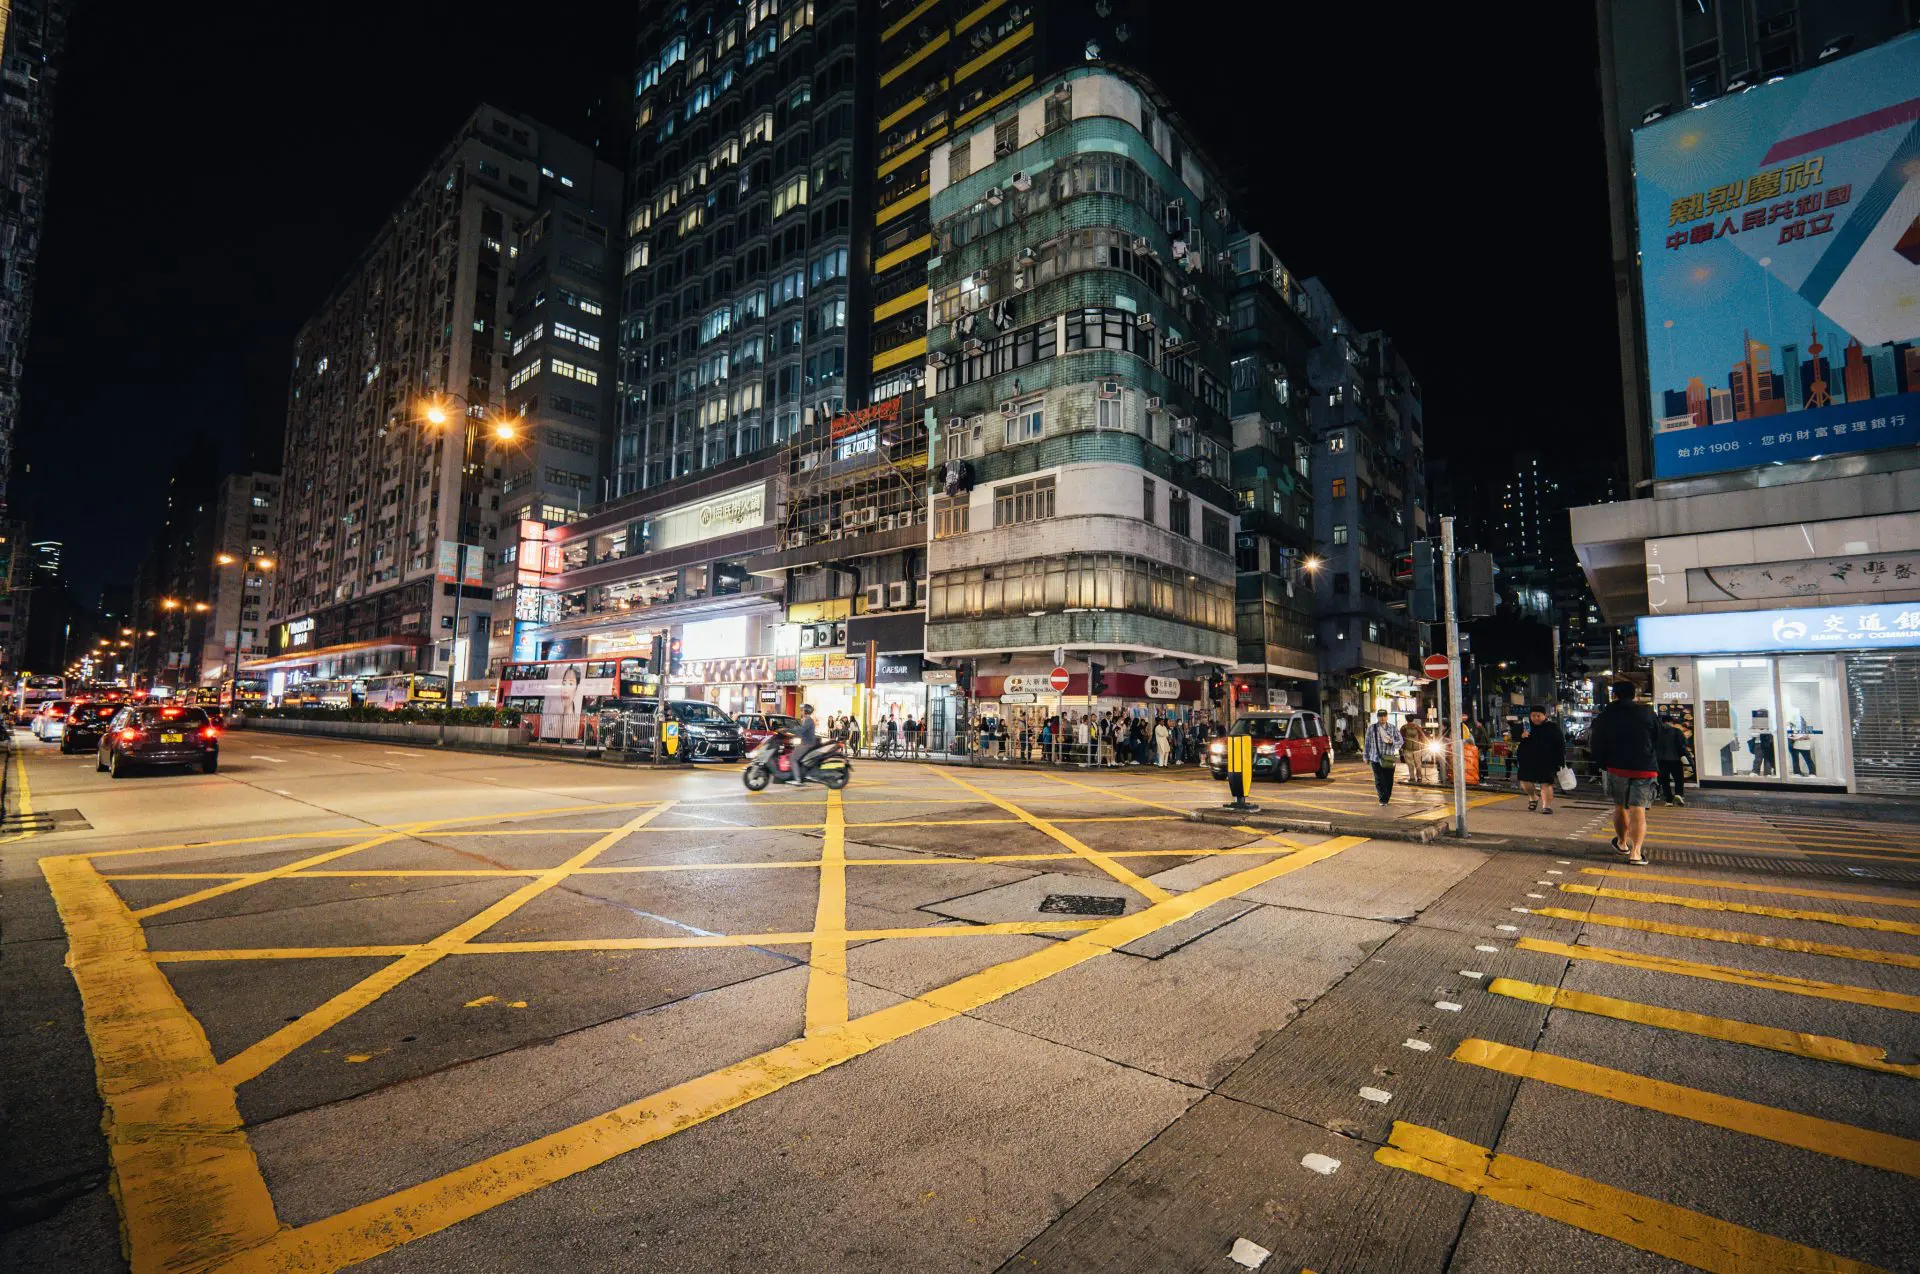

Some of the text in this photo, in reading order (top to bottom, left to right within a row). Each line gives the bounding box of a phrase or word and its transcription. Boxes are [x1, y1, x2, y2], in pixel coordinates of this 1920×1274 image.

[1667, 154, 1826, 227] 熱烈慶祝
[1665, 184, 1852, 251] 中華人民共和國
[1776, 213, 1835, 247] 成立
[1810, 634, 1843, 642] BANK
[1847, 633, 1864, 641] OF
[881, 665, 908, 674] CAESAR
